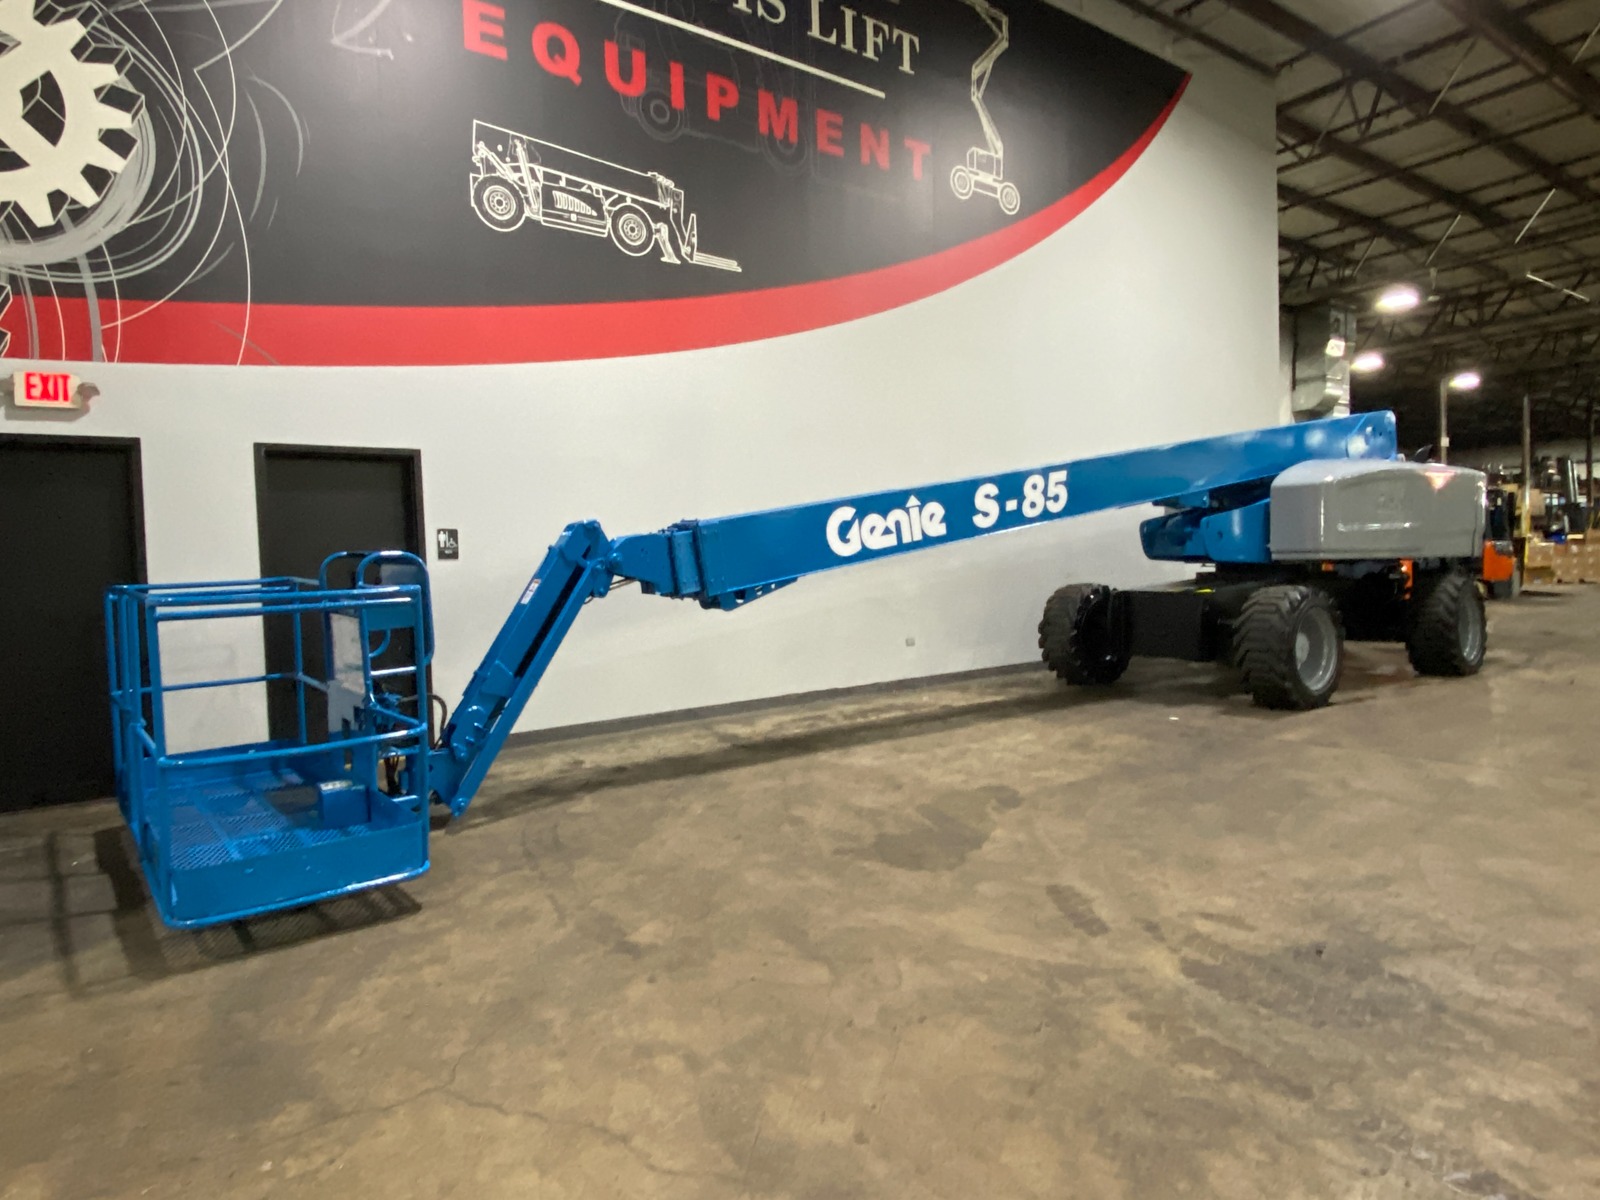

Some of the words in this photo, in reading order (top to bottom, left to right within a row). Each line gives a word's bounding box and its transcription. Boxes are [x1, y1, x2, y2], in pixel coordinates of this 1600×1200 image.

[807, 0, 920, 75] LIFT
[462, 0, 932, 180] EQUIPMENT
[25, 372, 70, 402] EXIT
[826, 494, 947, 556] Genie
[972, 470, 1068, 529] S-85
